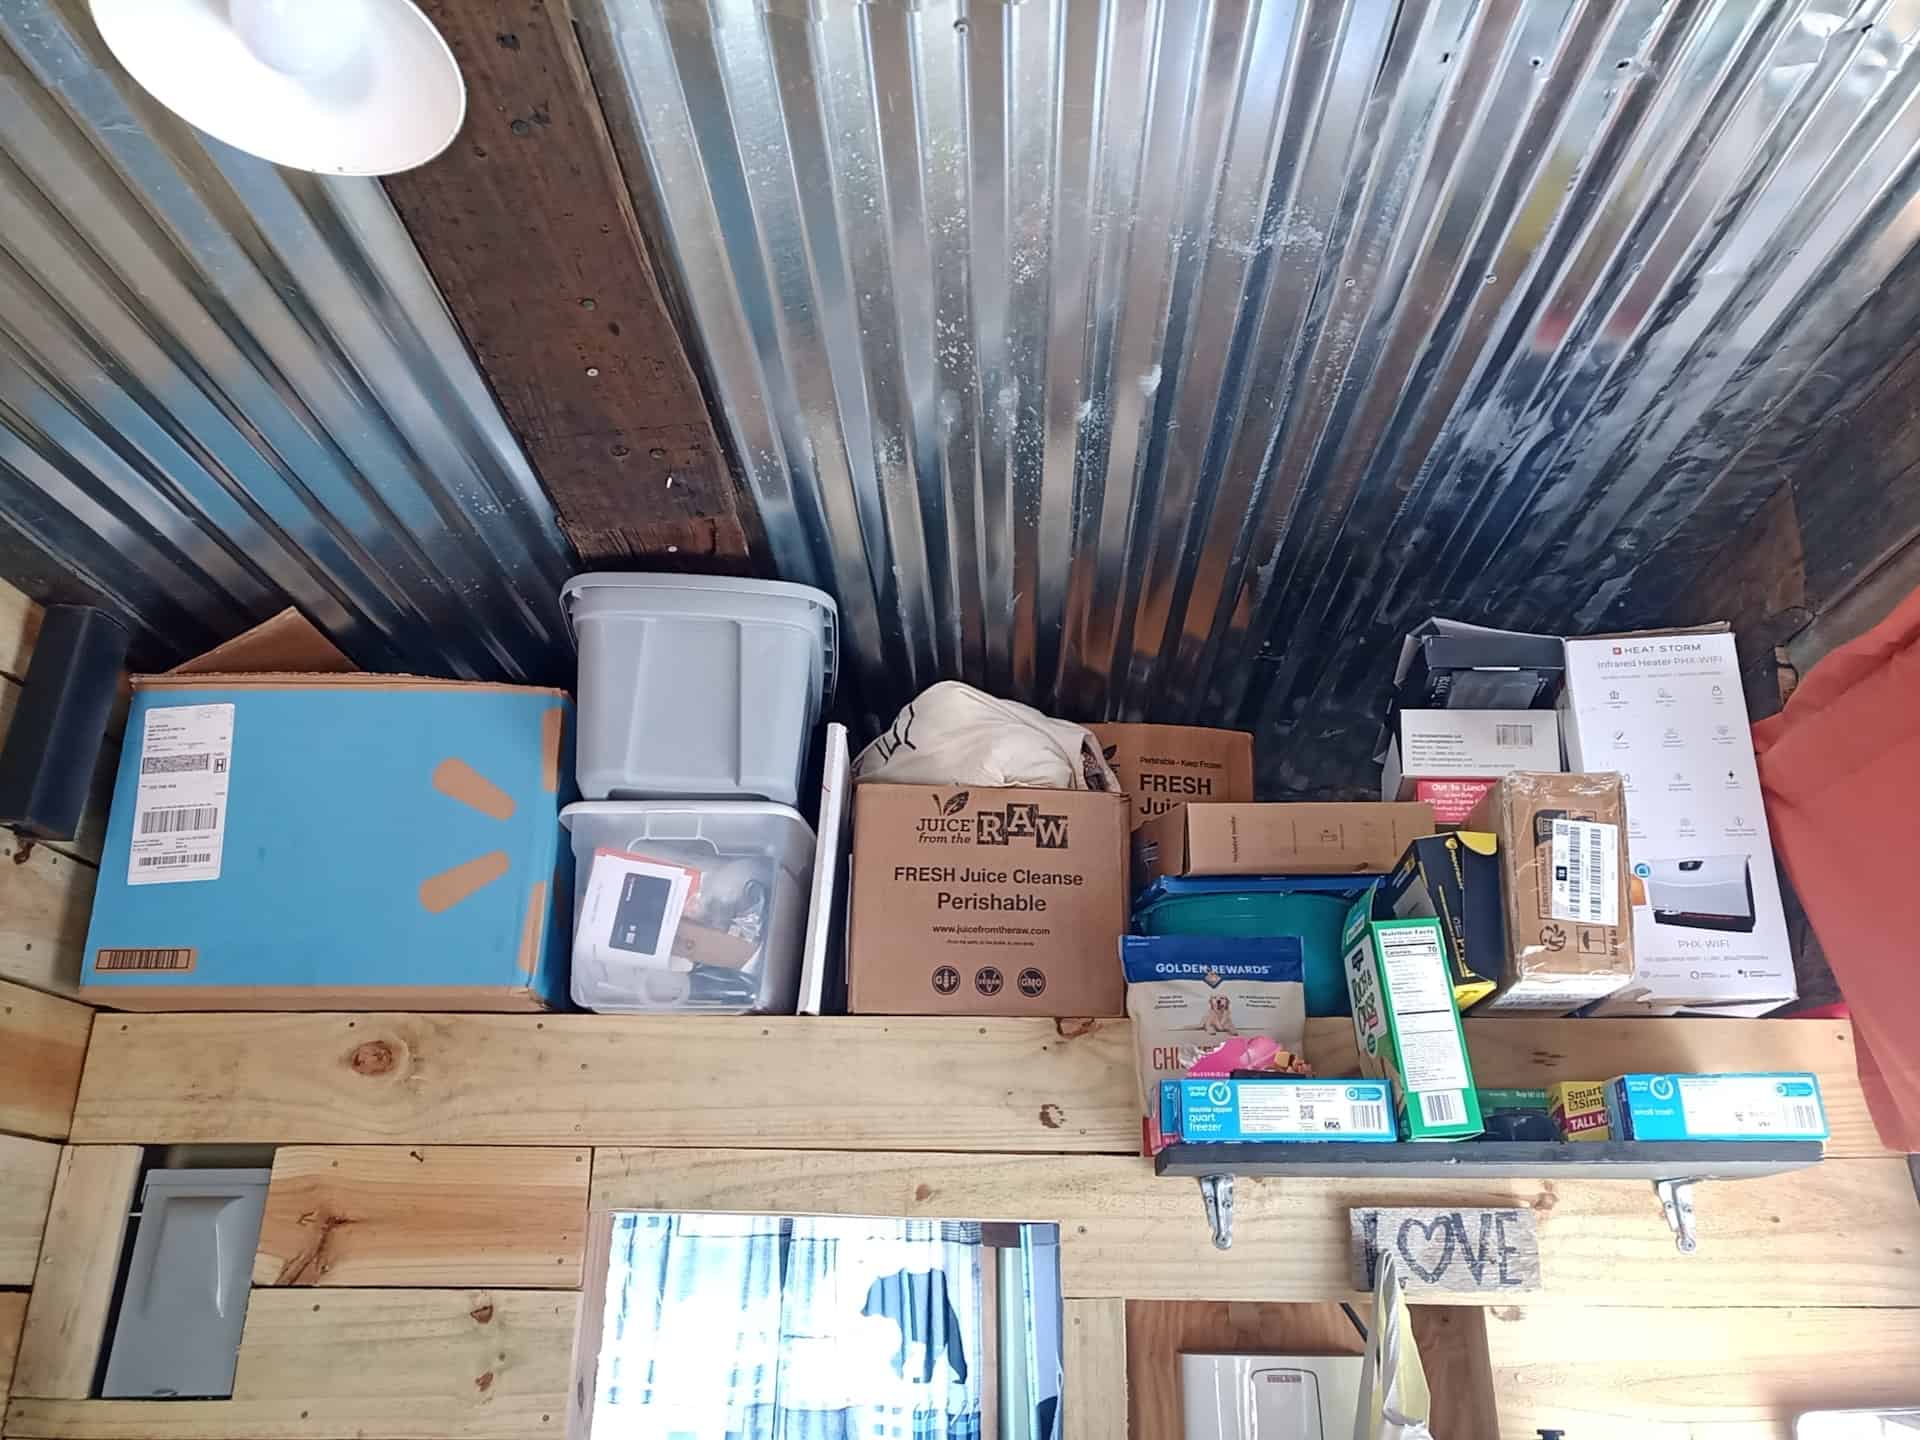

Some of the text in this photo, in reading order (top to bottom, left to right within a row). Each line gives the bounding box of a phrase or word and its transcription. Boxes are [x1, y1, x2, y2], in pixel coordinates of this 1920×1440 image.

[1624, 644, 1701, 654] HEAT STORM
[1140, 774, 1212, 795] FRESH
[916, 818, 972, 832] JUICE
[918, 803, 1069, 849] from the RAW
[894, 867, 1084, 886] FRESH Juice Cleanse
[937, 892, 1047, 912] Perishable
[932, 924, 1051, 936] www.juicefromtheraw.com
[1155, 963, 1270, 975] GOLDEN REWARDS
[1189, 1113, 1216, 1123] quart
[1570, 1116, 1595, 1130] TALL
[1189, 1122, 1222, 1132] freezer
